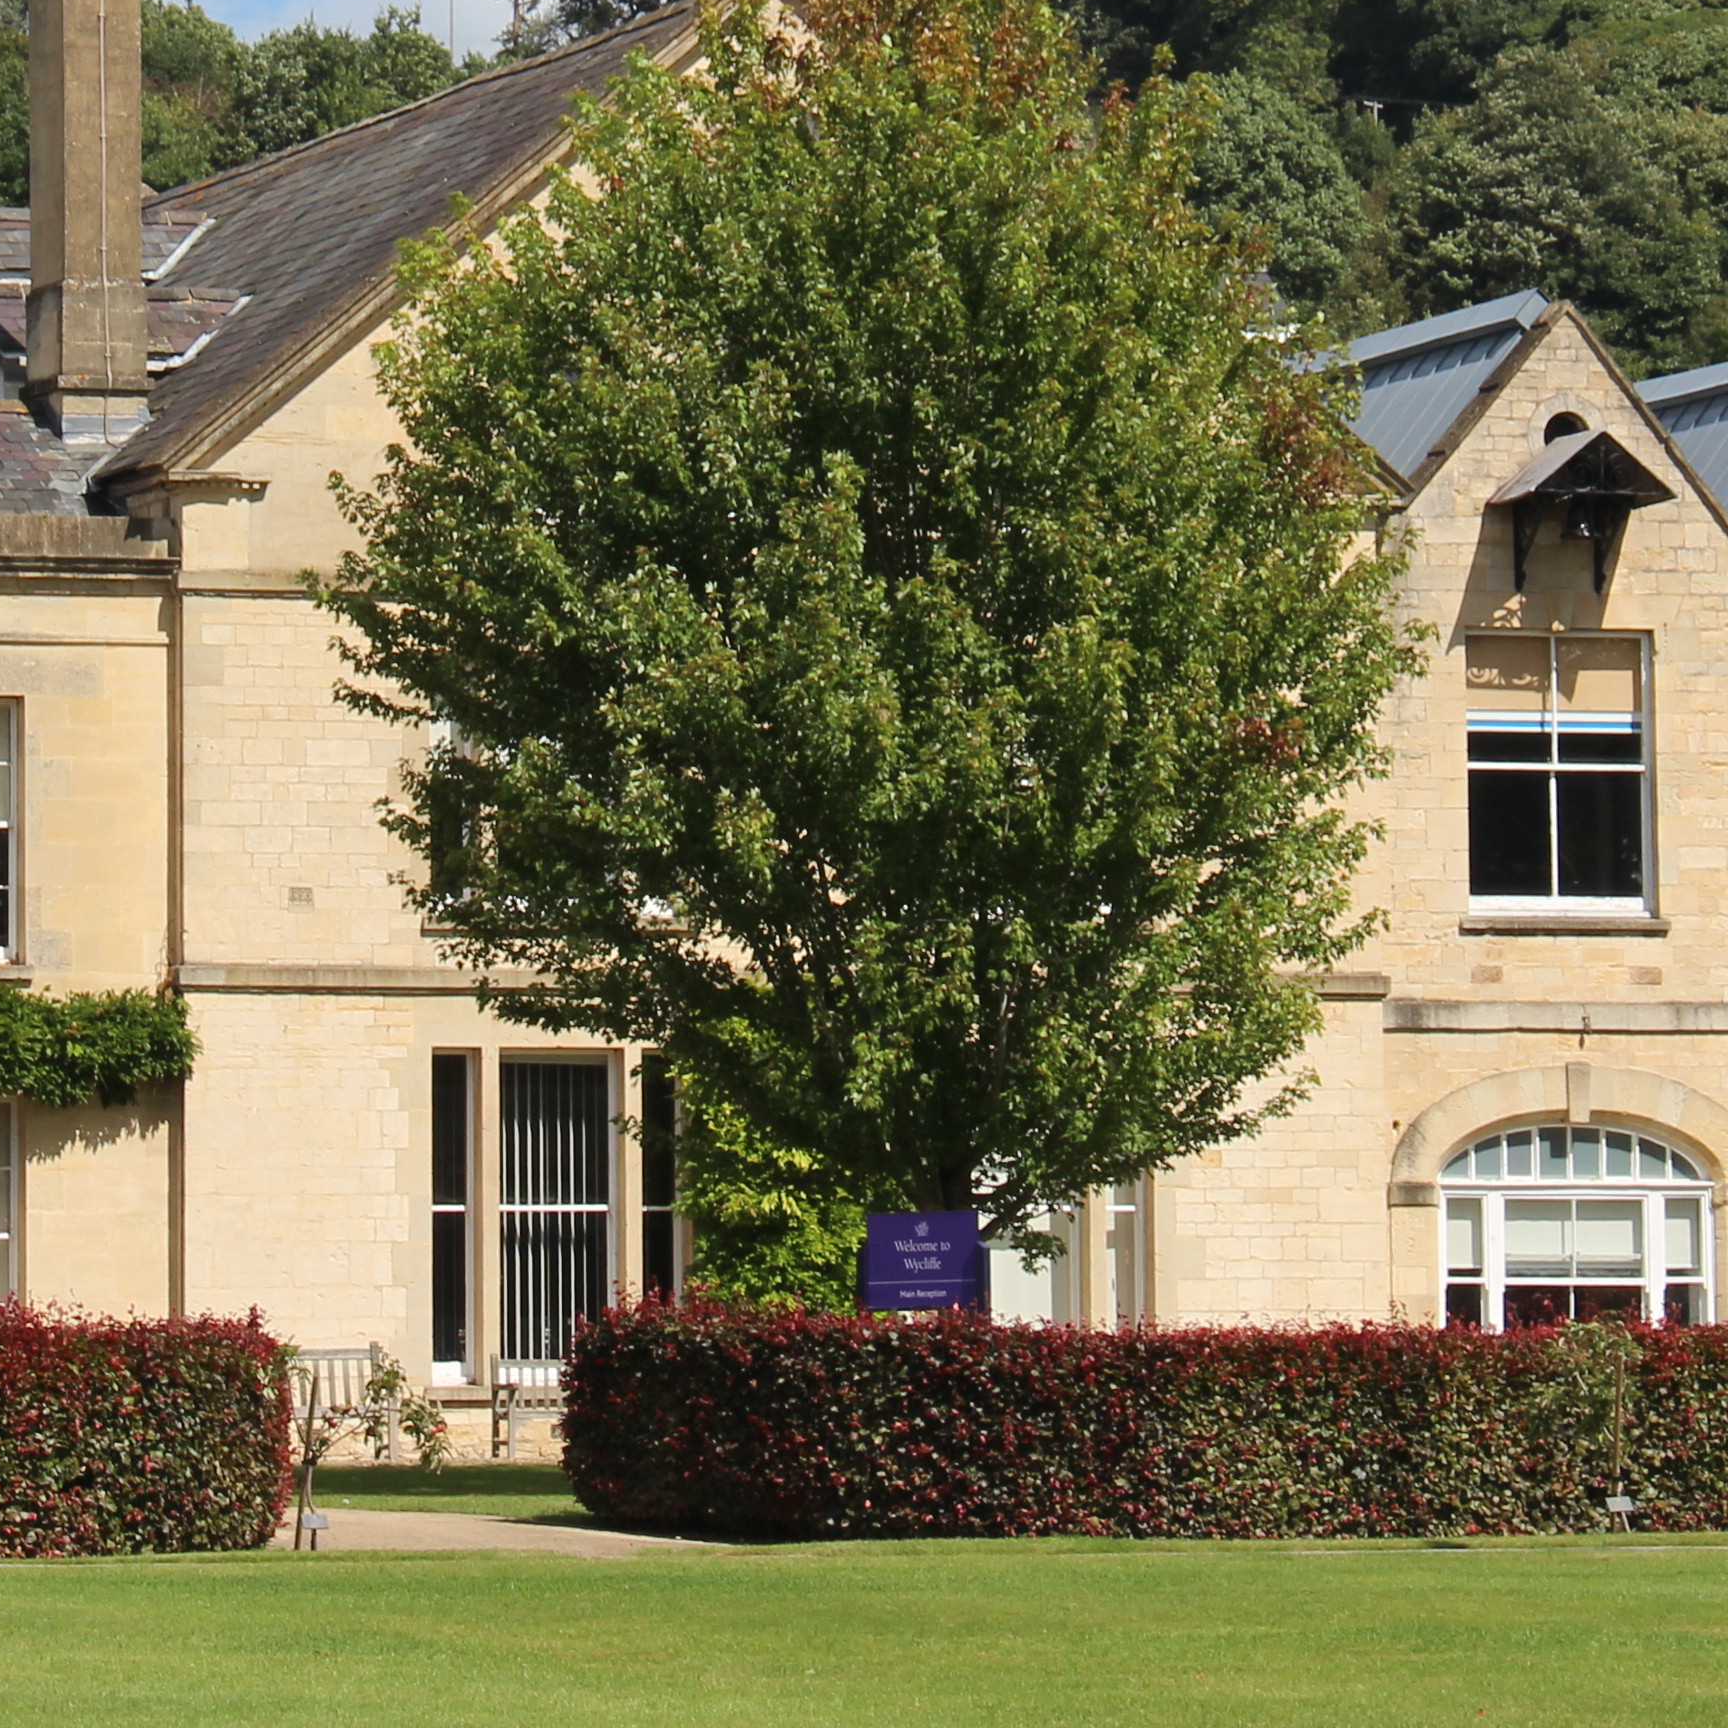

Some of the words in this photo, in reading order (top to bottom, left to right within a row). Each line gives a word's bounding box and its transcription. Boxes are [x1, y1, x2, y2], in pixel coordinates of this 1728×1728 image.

[894, 1239, 938, 1252] Welcome
[940, 1241, 951, 1251] to
[903, 1257, 941, 1273] Wycliffe
[899, 1290, 915, 1298] Main
[916, 1289, 947, 1299] Reception
